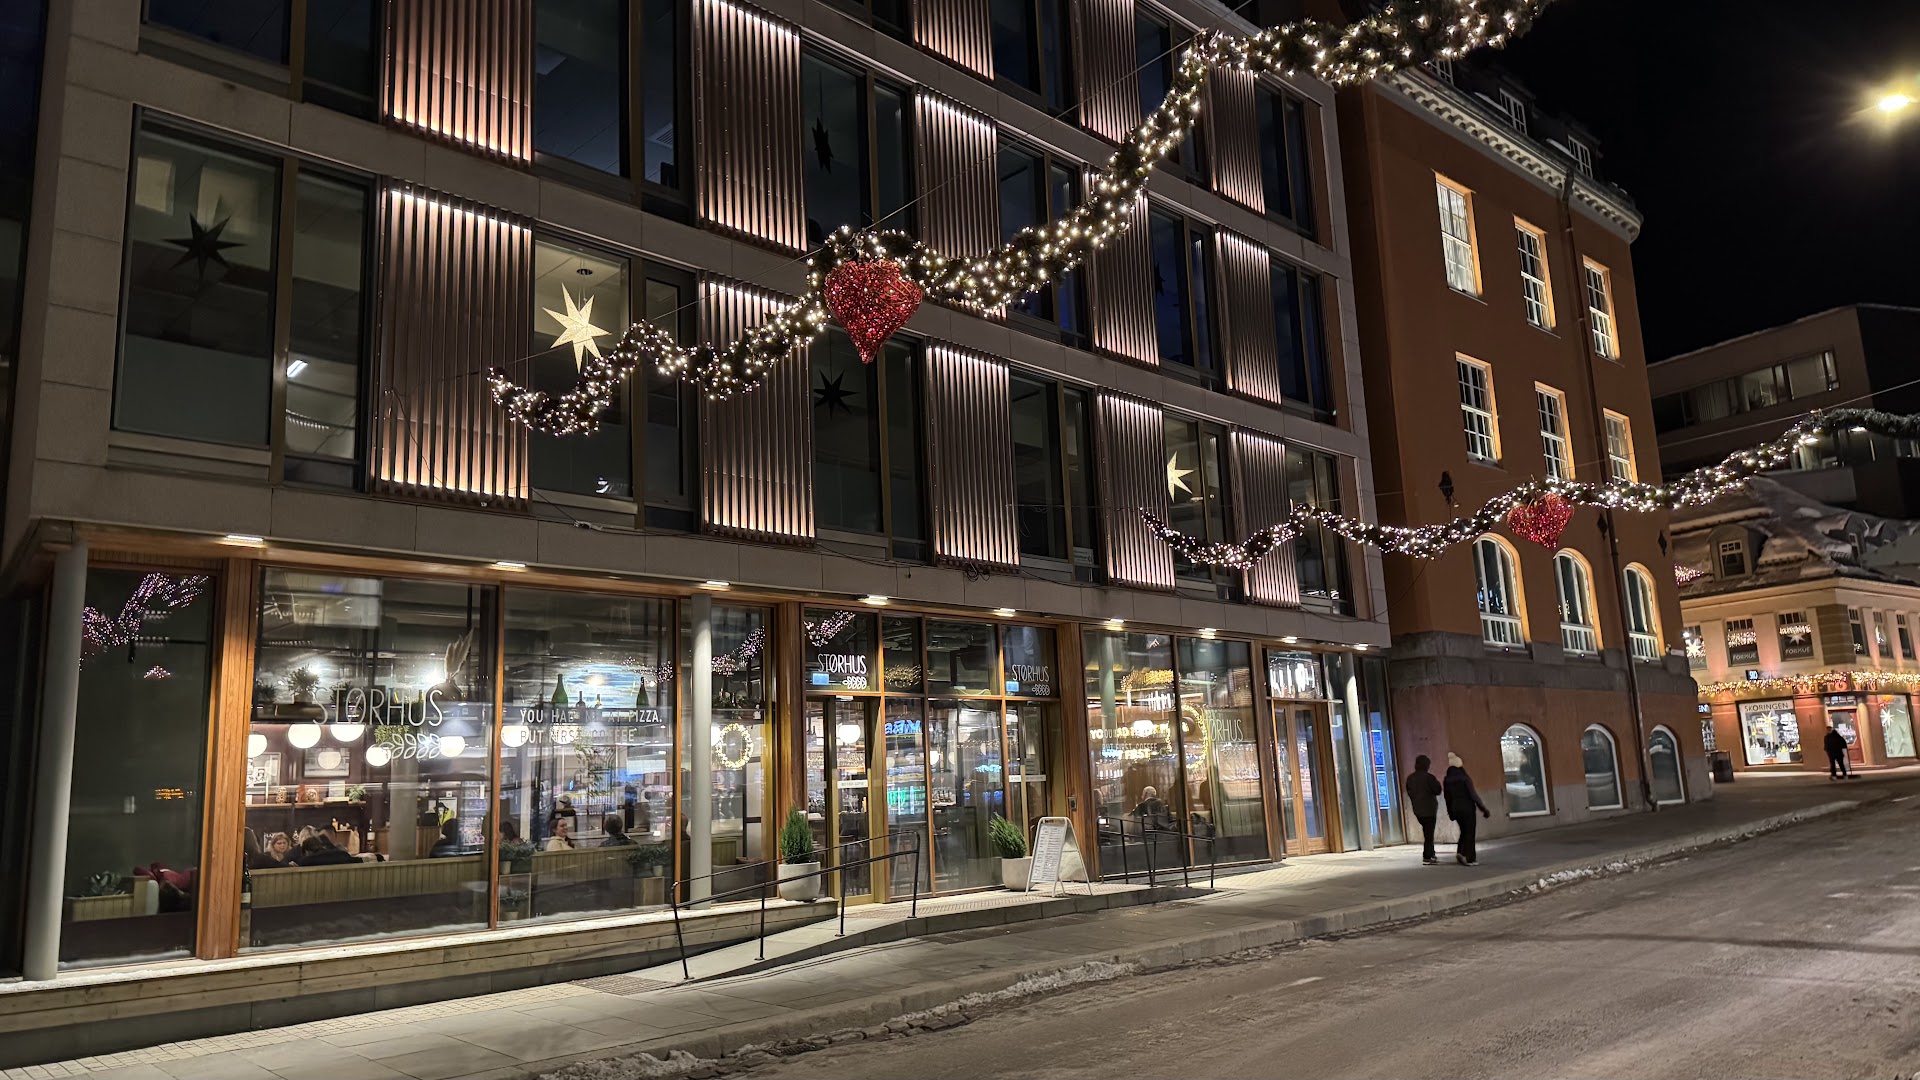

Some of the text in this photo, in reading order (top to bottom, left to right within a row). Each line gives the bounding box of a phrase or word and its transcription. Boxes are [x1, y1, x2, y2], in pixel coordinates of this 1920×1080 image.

[818, 653, 867, 674] STØRHUS
[1012, 664, 1050, 682] STØRHUS
[312, 687, 443, 727] STØRHUS
[1744, 702, 1789, 711] SKORINGEN
[520, 709, 544, 723] YOU
[551, 709, 576, 722] HAD
[628, 709, 662, 723] PIZZA.
[520, 729, 544, 743] BUT
